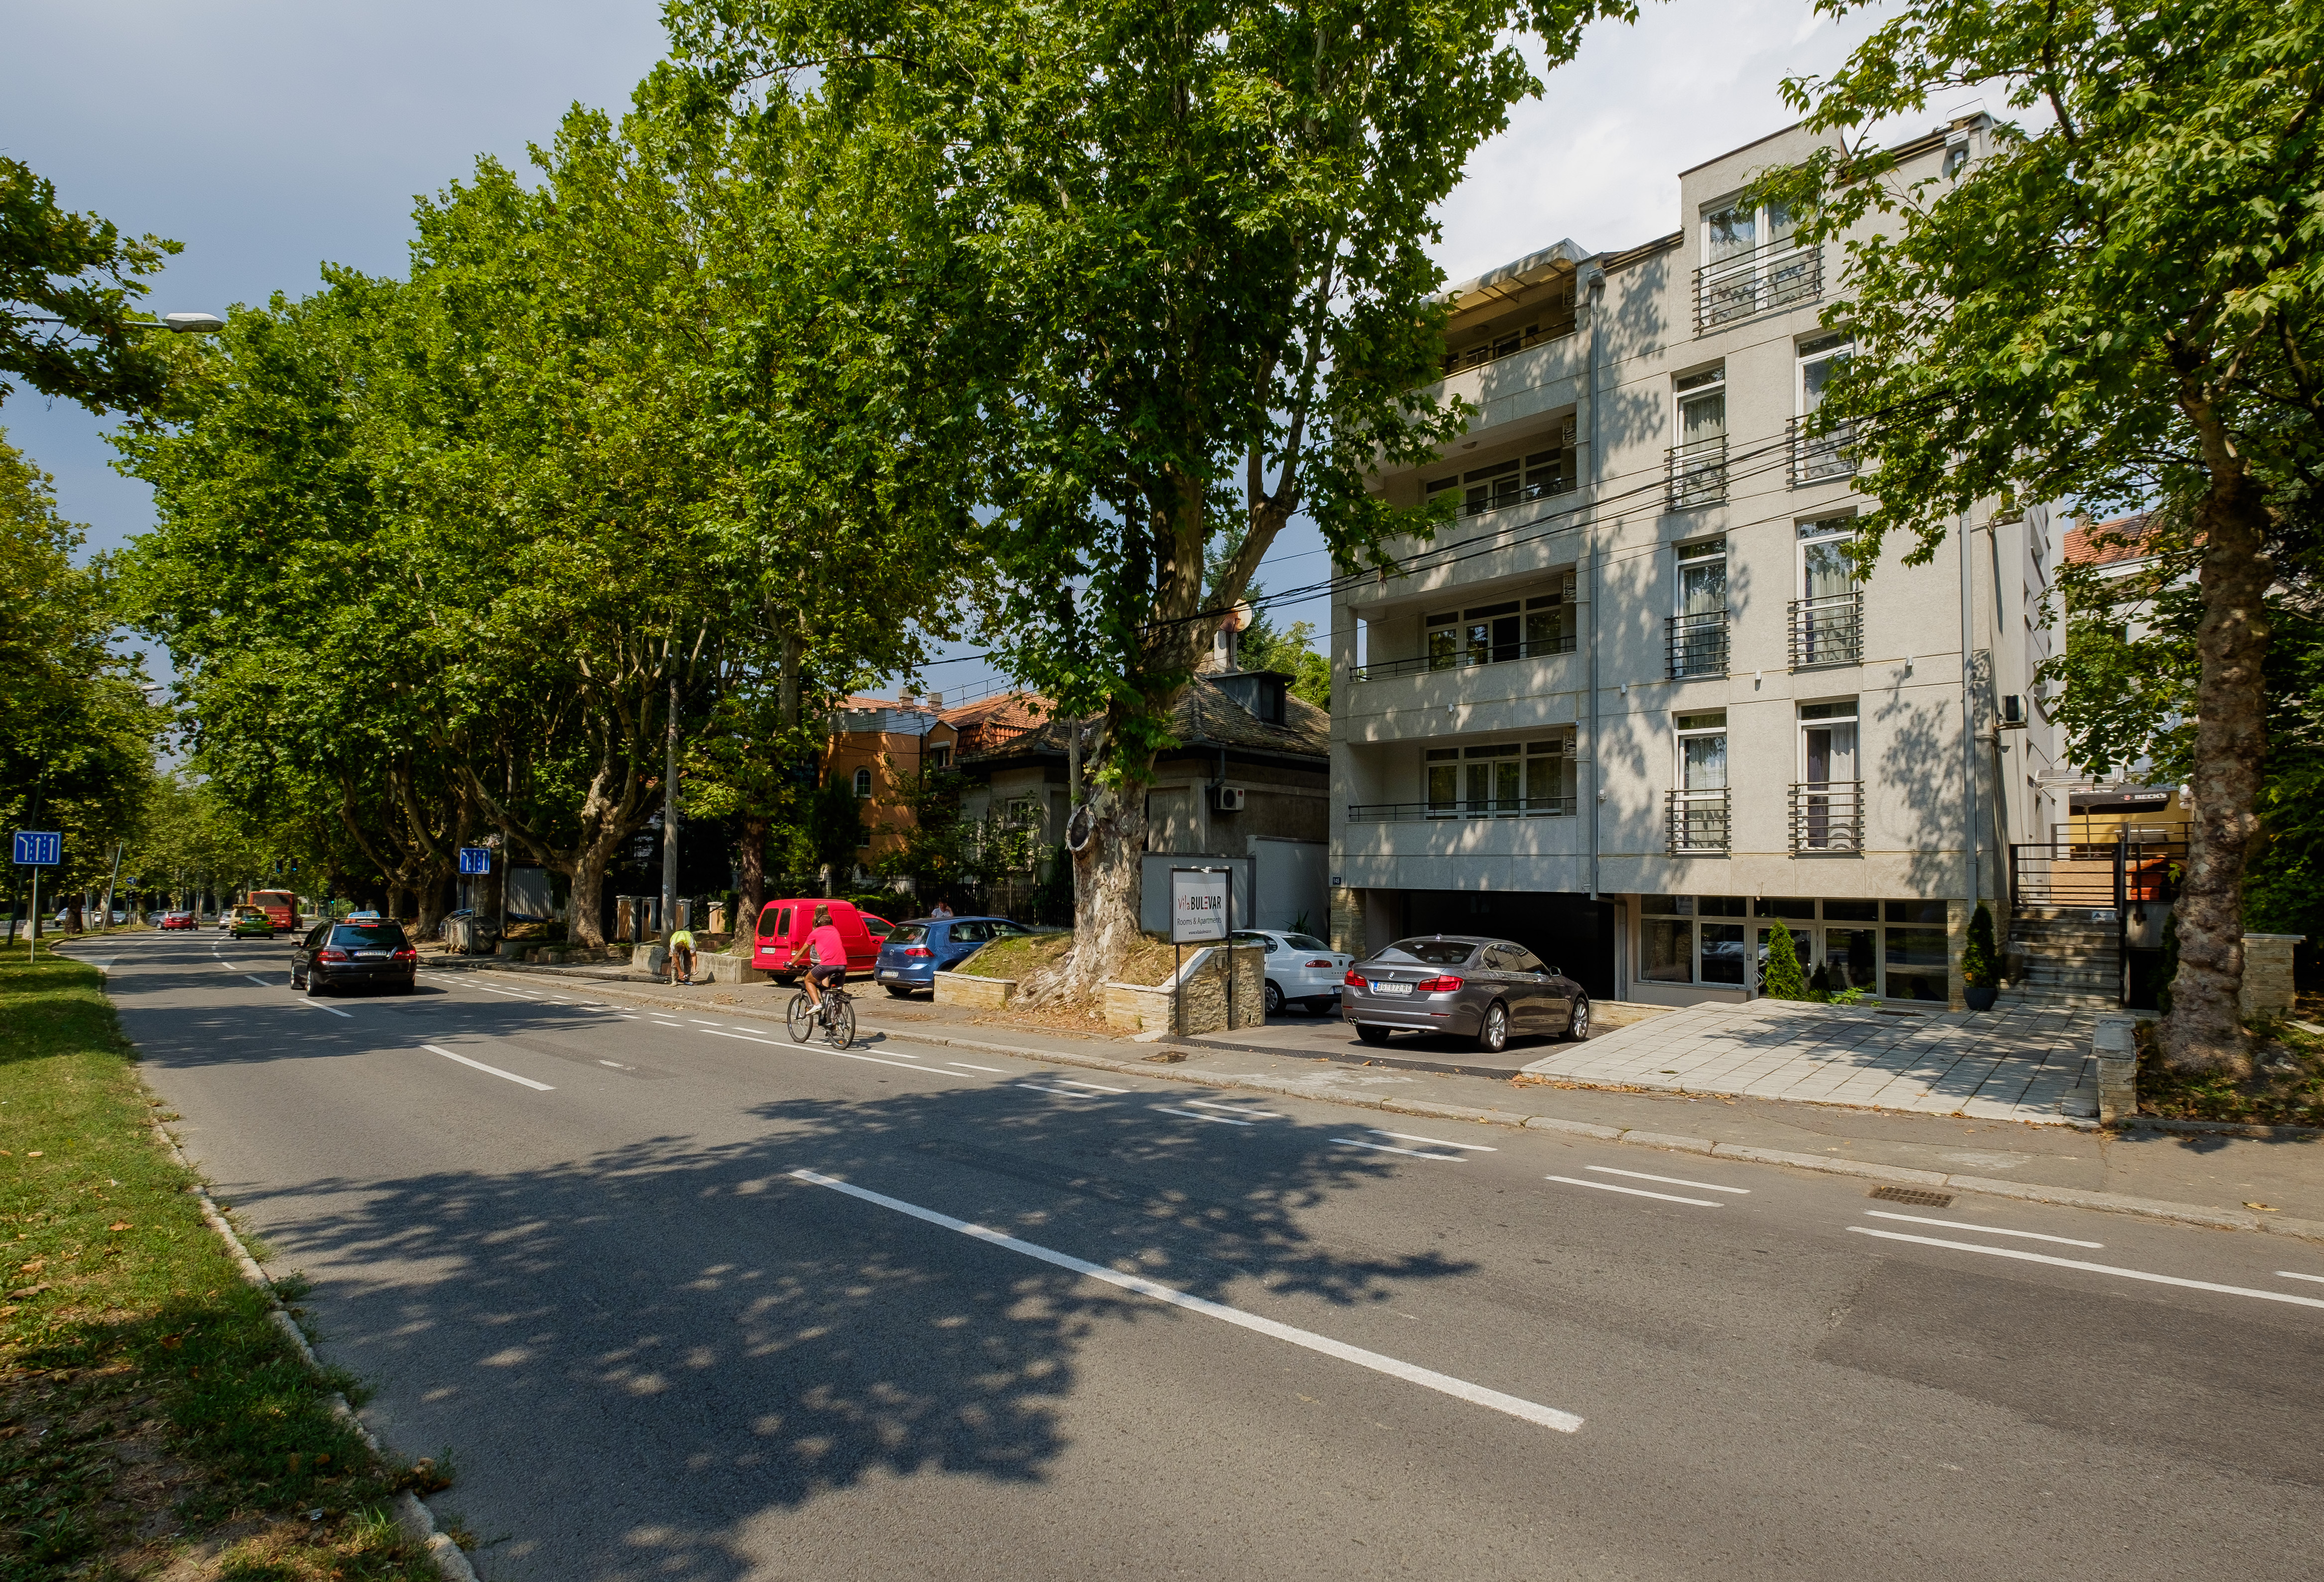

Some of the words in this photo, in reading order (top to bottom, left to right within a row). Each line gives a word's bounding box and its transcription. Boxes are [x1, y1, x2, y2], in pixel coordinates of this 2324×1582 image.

[1178, 894, 1190, 912] Vila
[1191, 896, 1222, 910] BULEVAR
[1197, 917, 1222, 926] Apartments
